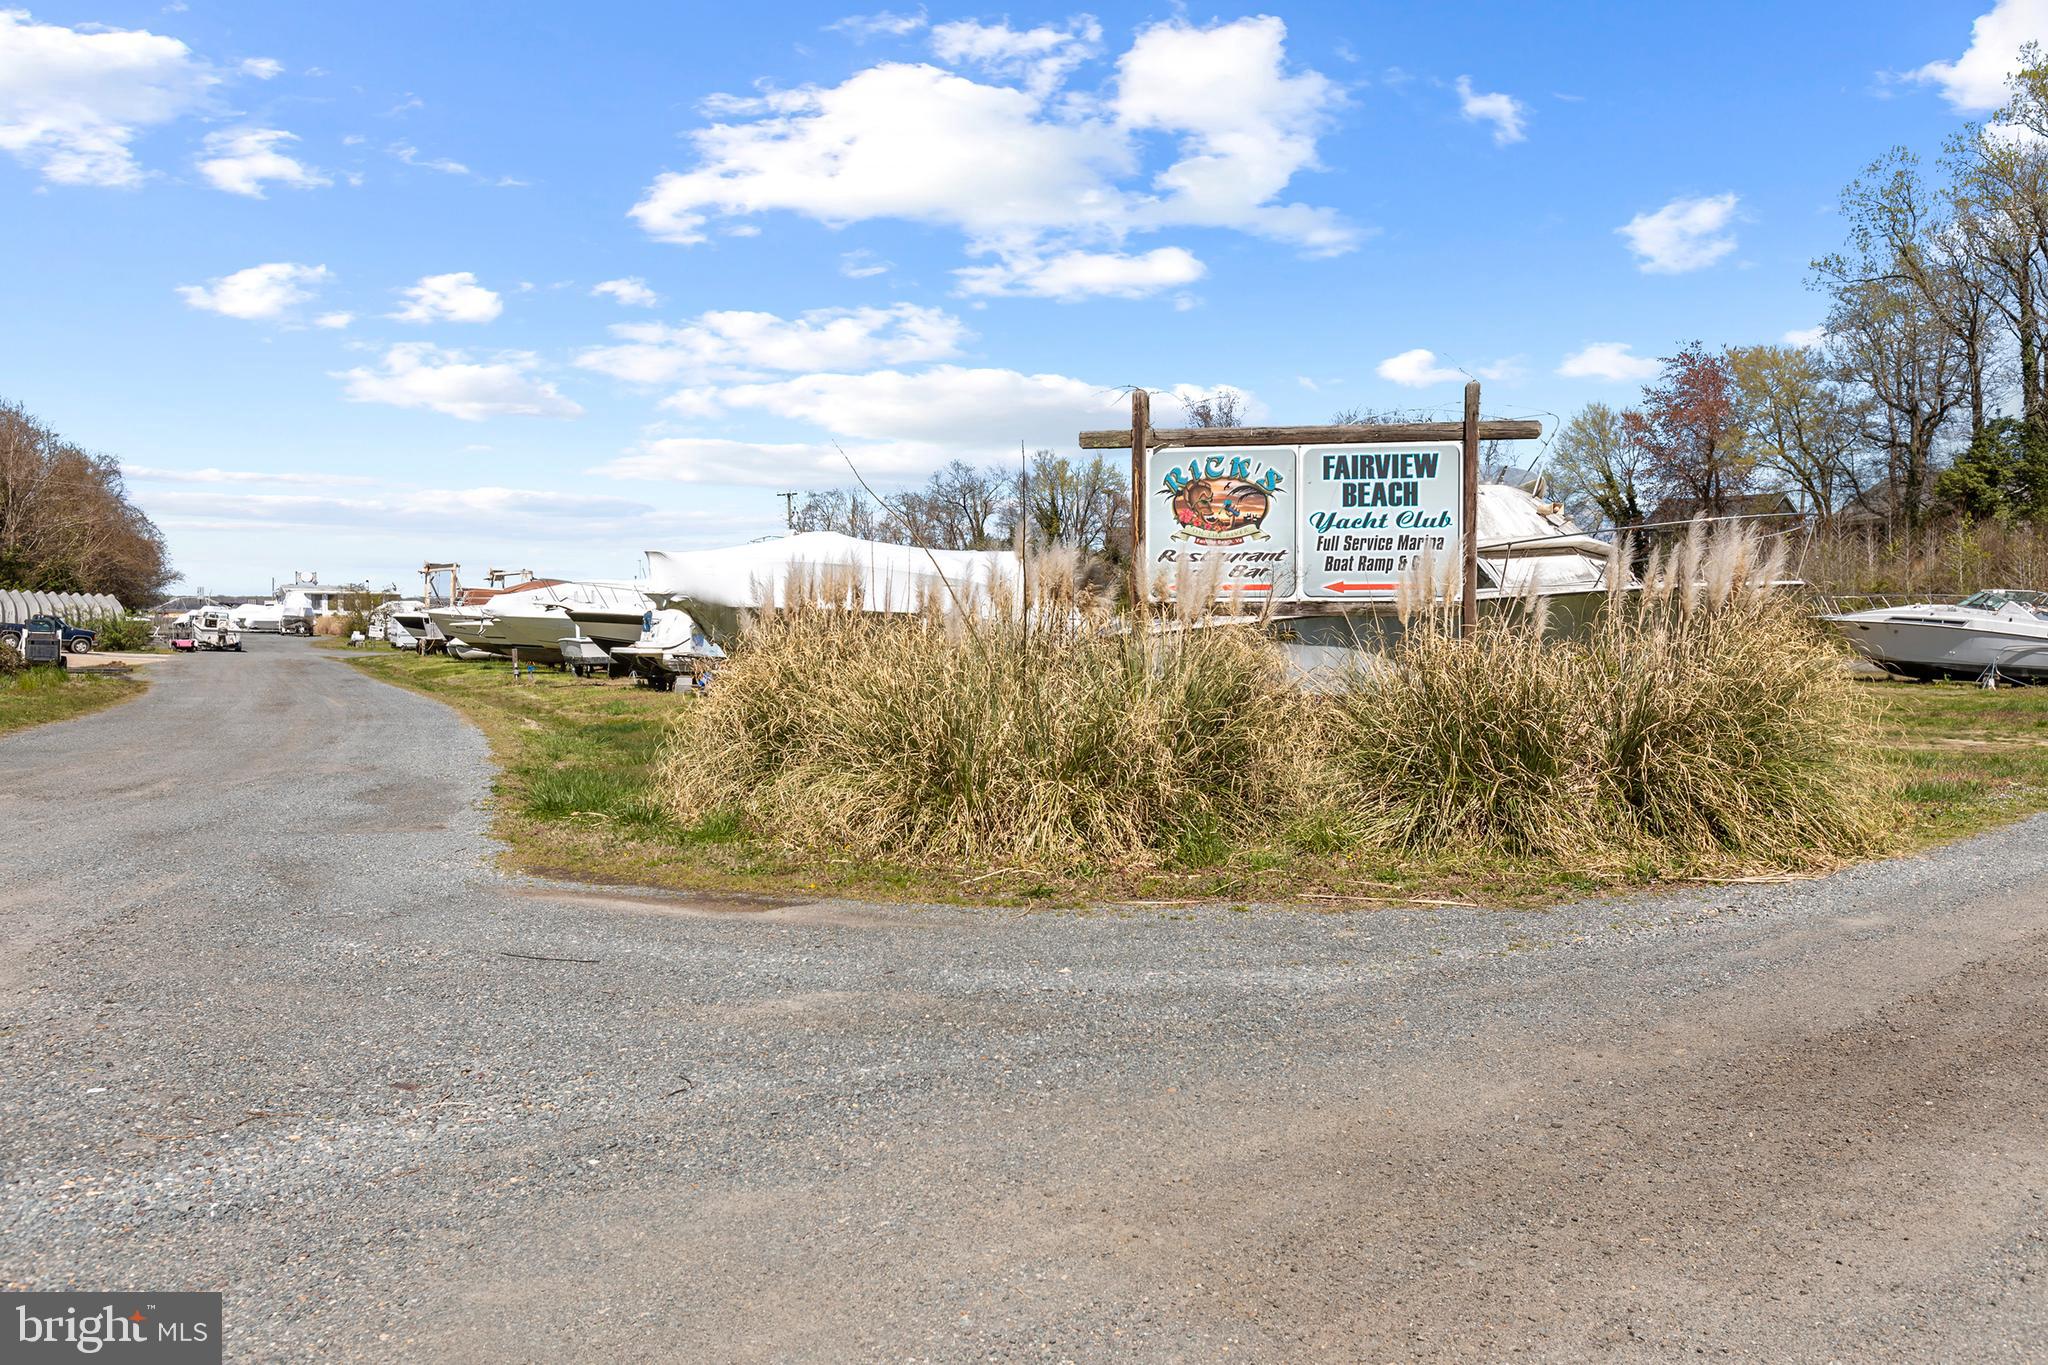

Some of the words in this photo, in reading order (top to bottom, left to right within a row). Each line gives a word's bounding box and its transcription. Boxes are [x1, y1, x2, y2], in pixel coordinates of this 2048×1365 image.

[1163, 455, 1283, 495] RICK'S
[1323, 453, 1439, 480] FAIRVIEW
[1342, 481, 1418, 507] BEACH
[1309, 511, 1388, 533] Yacht
[1396, 510, 1453, 528] Club
[1316, 535, 1340, 551] Full
[1343, 535, 1394, 551] Service
[1157, 550, 1288, 563] Rsurant
[1324, 555, 1354, 571] Boat
[1357, 556, 1394, 574] Ramp
[1397, 555, 1408, 571] &
